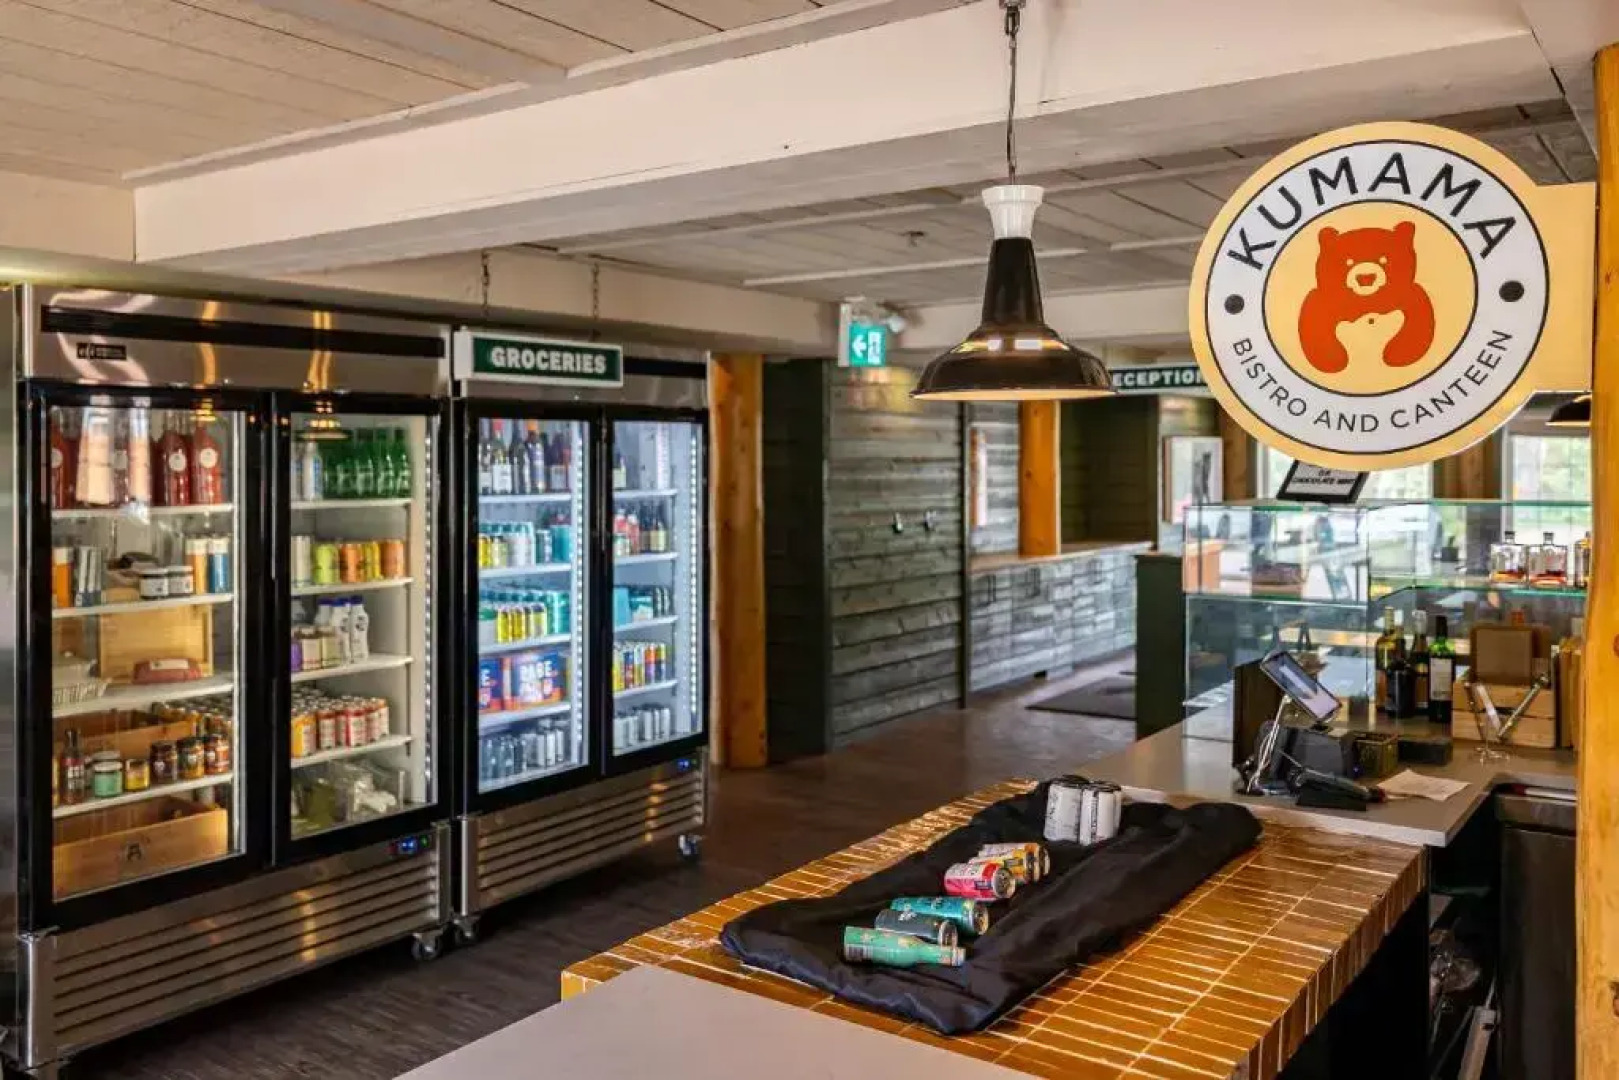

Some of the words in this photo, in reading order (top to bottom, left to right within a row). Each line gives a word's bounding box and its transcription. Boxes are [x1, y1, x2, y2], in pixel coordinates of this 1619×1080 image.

[1227, 152, 1517, 271] KUMAMA
[490, 347, 607, 374] GROCERIES
[1232, 337, 1307, 417] BISTRO
[1313, 410, 1379, 433] AND
[1389, 330, 1514, 429] CANTEEN
